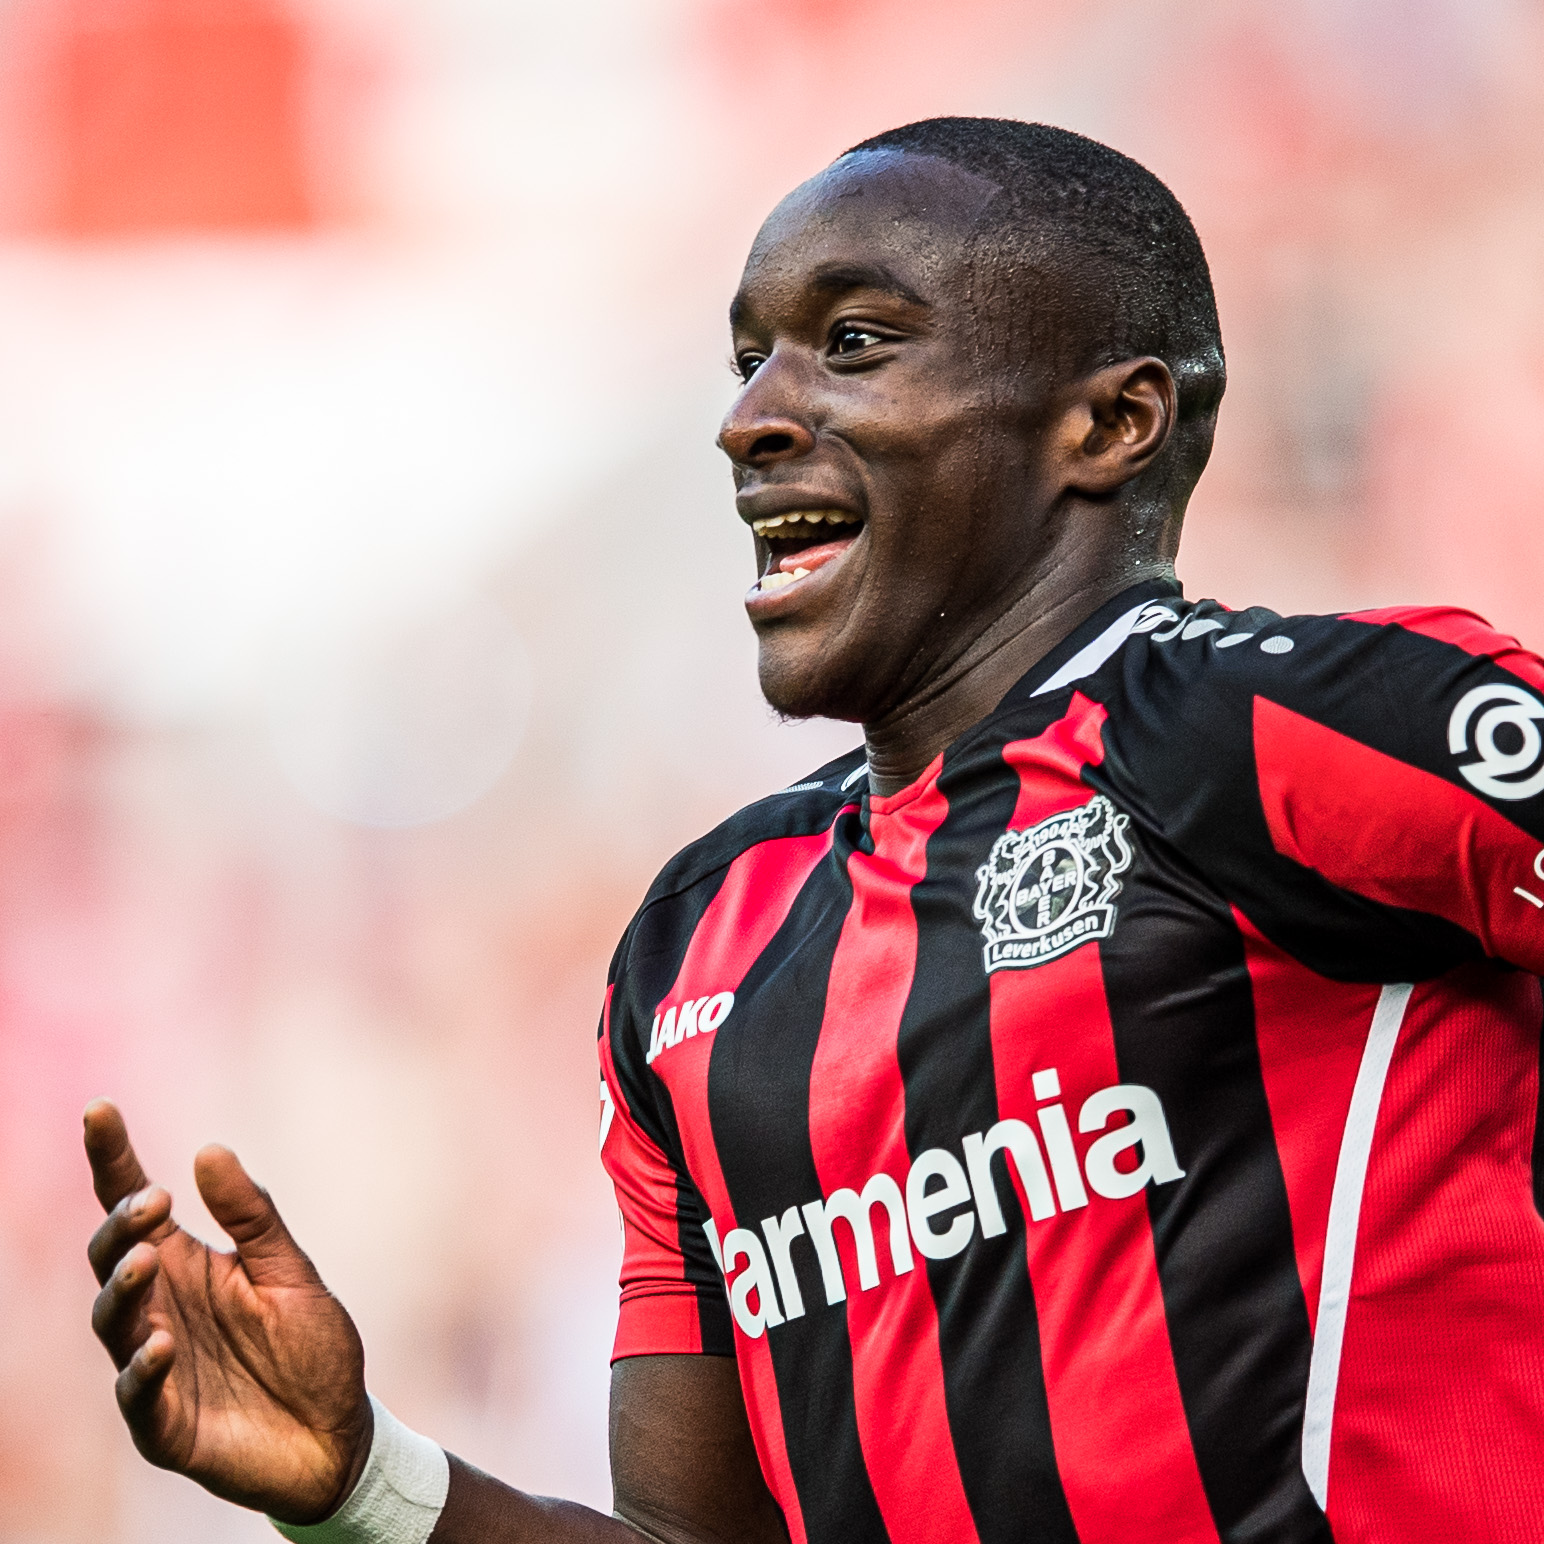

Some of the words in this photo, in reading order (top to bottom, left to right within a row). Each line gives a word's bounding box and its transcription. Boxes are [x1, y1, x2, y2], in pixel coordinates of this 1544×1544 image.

[1015, 870, 1077, 907] BAYER
[992, 914, 1098, 961] Leverkusen
[646, 991, 735, 1065] JAKO
